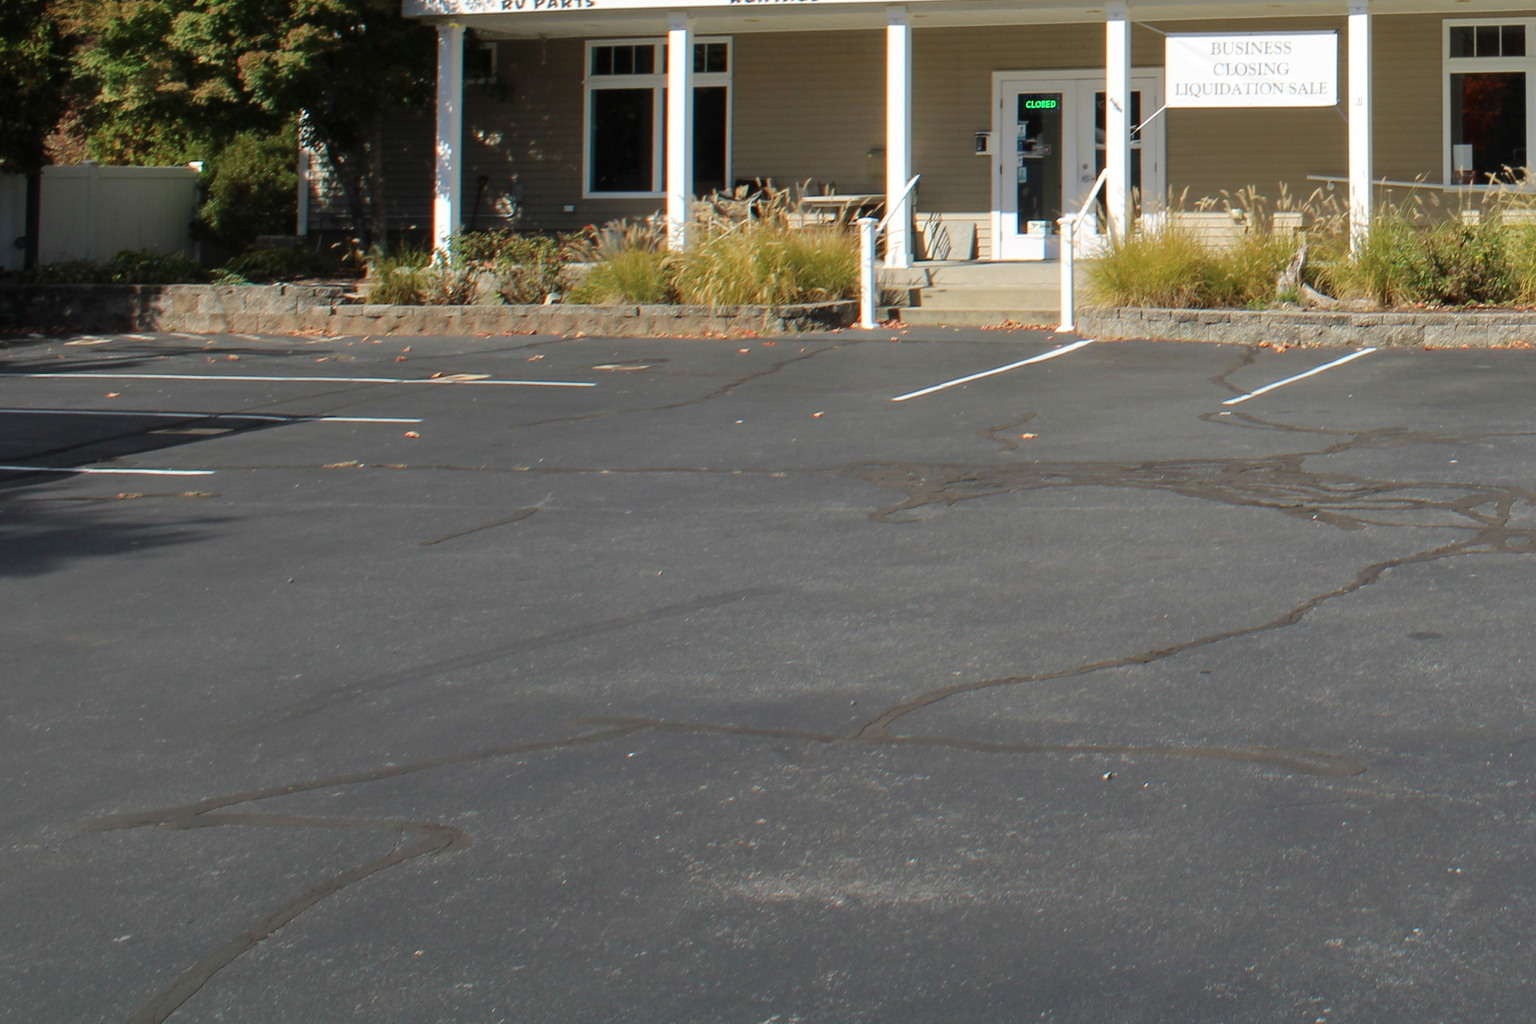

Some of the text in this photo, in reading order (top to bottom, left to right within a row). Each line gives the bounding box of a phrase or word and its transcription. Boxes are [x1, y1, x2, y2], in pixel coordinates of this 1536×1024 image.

[1211, 40, 1292, 56] BUSINESS
[1213, 62, 1290, 76] CLOSING
[1175, 81, 1328, 97] LIQUIDATION SALE
[1025, 100, 1057, 109] CLOSED
